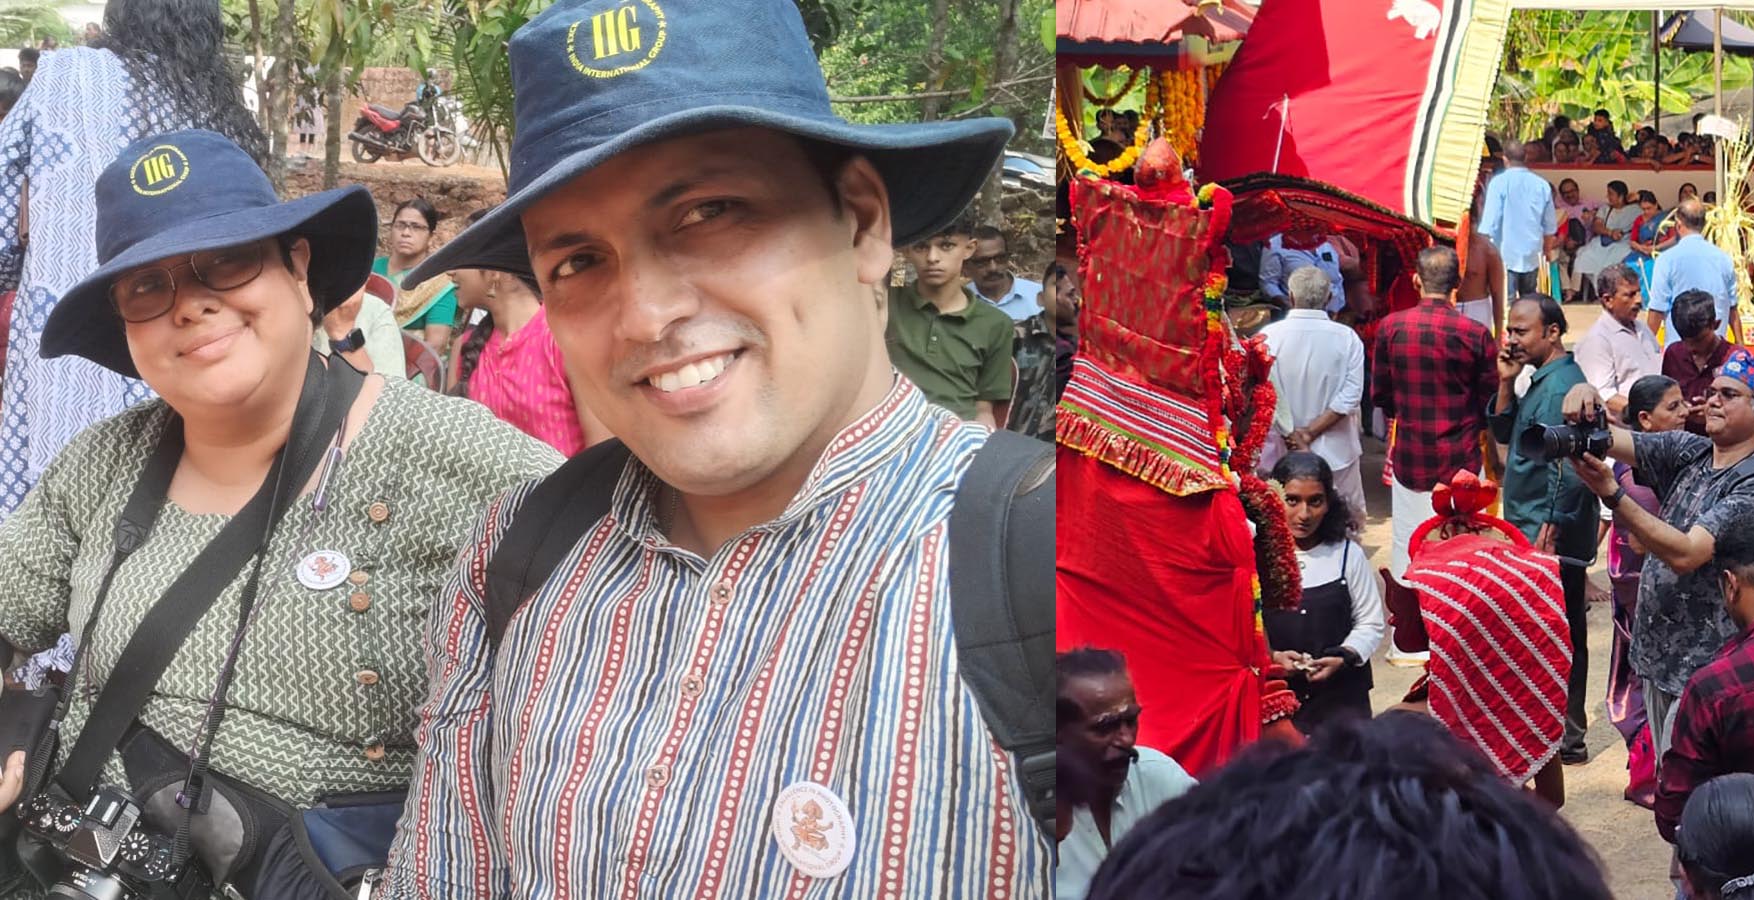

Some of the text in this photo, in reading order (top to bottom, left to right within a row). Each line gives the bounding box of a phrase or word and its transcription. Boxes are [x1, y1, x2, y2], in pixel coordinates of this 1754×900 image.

[592, 6, 641, 60] IIG
[648, 30, 667, 59] GROUP
[144, 153, 175, 186] IIG
